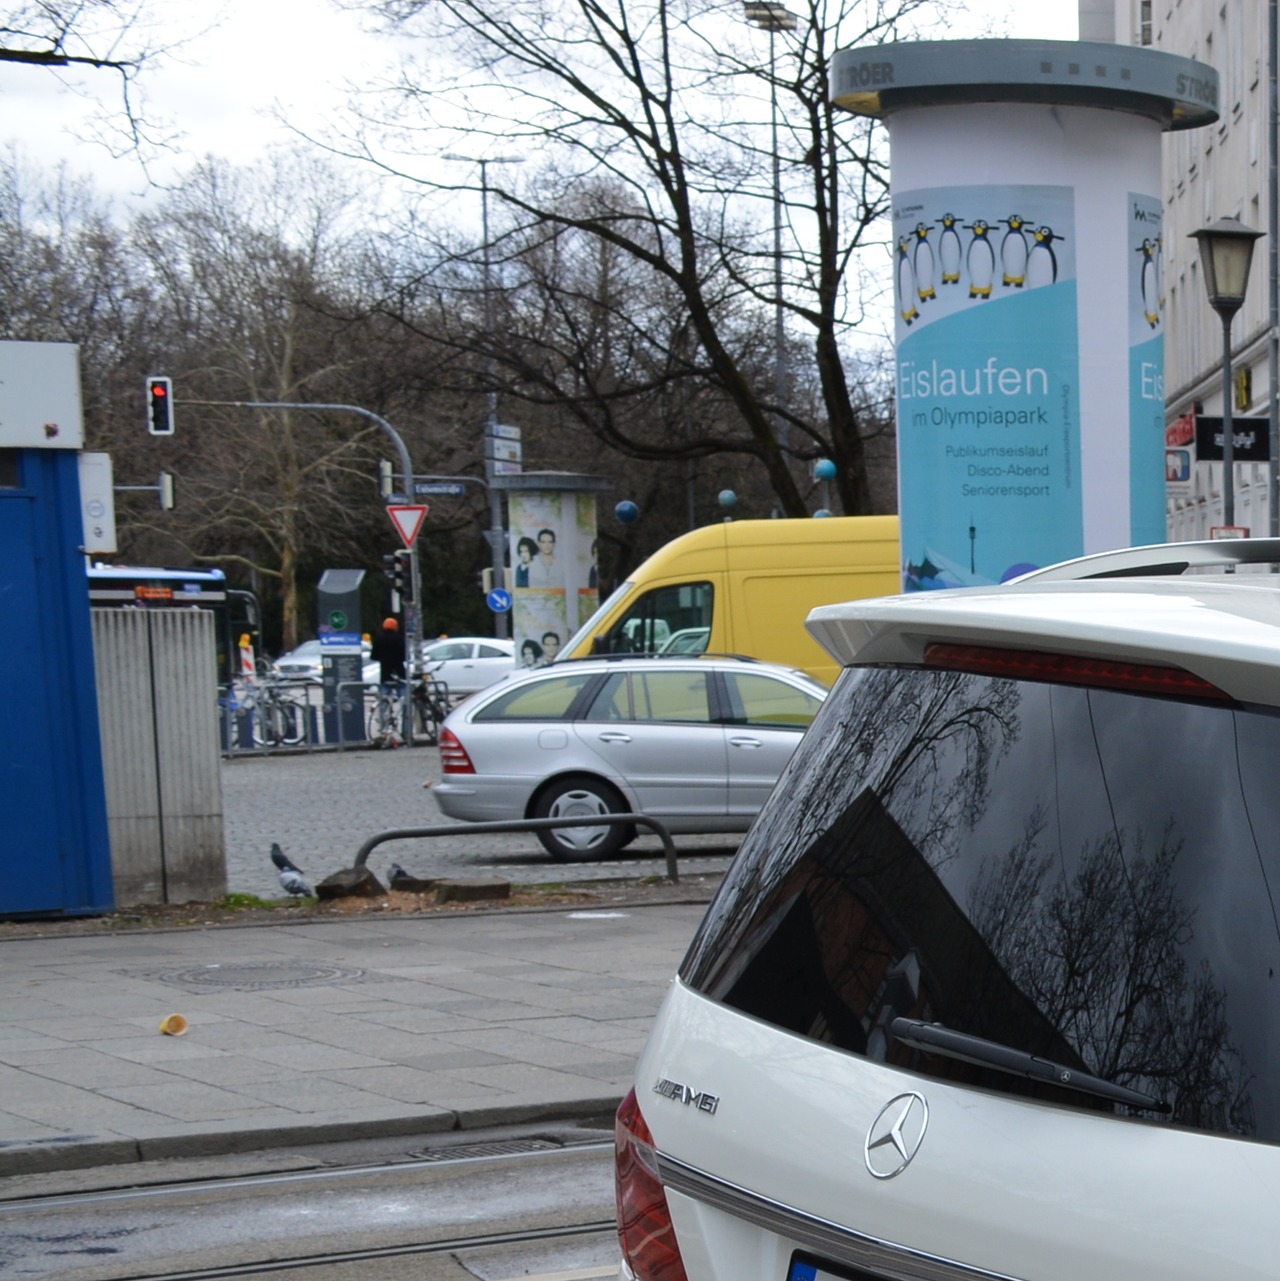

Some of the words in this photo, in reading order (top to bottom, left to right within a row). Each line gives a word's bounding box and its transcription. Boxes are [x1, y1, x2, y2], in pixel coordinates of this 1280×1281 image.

[900, 356, 1049, 400] Eislaufen
[912, 410, 927, 428] im
[931, 406, 1048, 429] Olympiapark
[946, 445, 1049, 459] Publikumseislauf
[967, 464, 1049, 477] Disco-Abend
[962, 484, 1050, 498] Seniorensport
[671, 1082, 721, 1116] AMG
